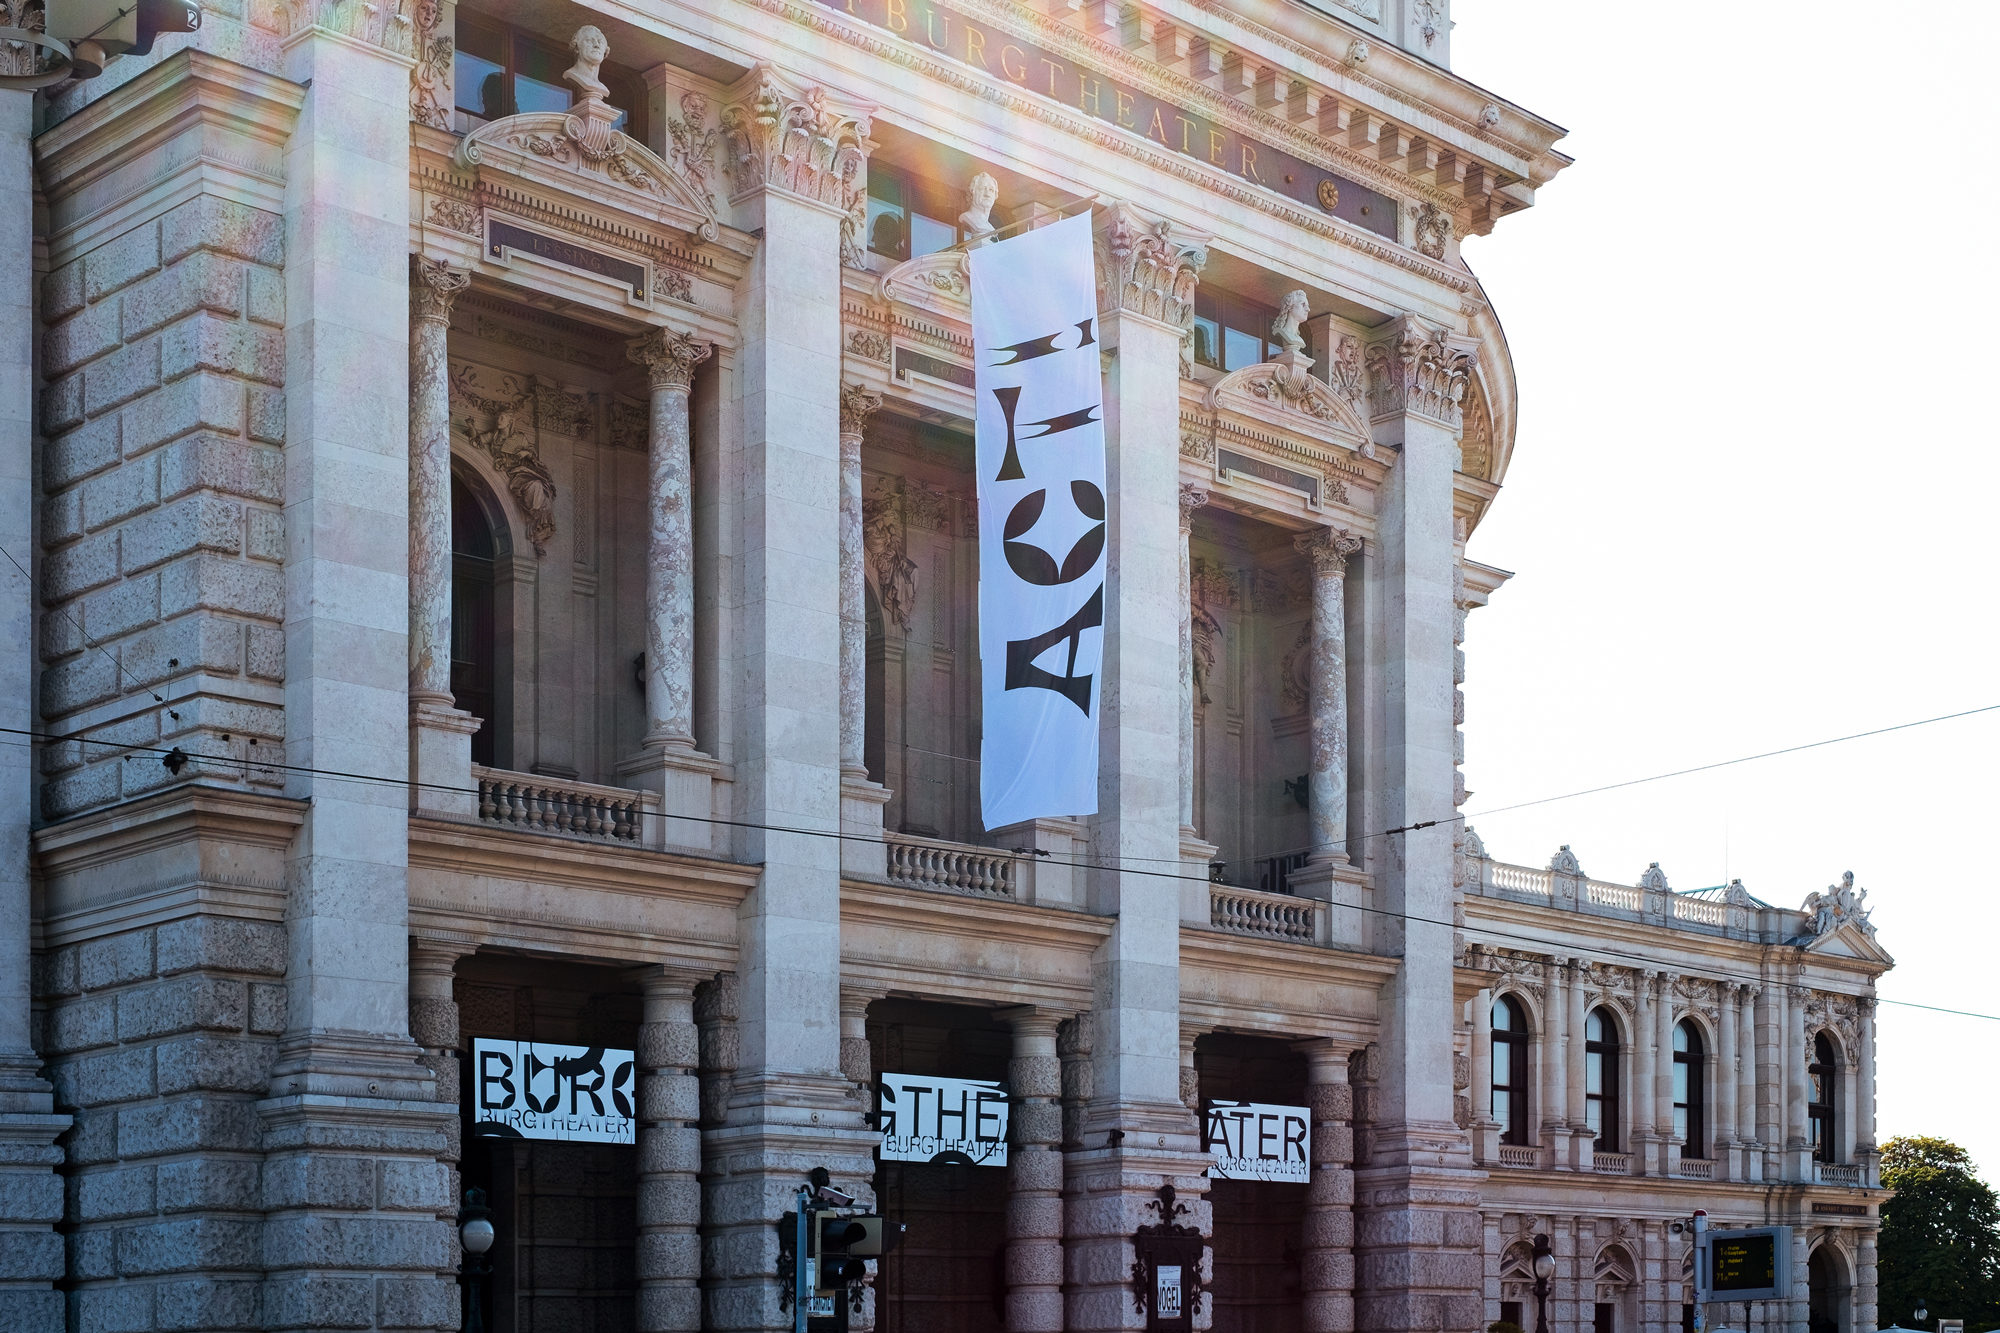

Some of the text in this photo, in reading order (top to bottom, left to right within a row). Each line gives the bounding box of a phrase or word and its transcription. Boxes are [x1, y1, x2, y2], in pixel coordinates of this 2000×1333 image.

[188, 11, 197, 28] 2
[986, 316, 1106, 719] ACT!
[481, 1108, 629, 1134] BURGTHEATER
[886, 1134, 1005, 1157] BURGTHEATER
[1207, 1110, 1307, 1163] ATER
